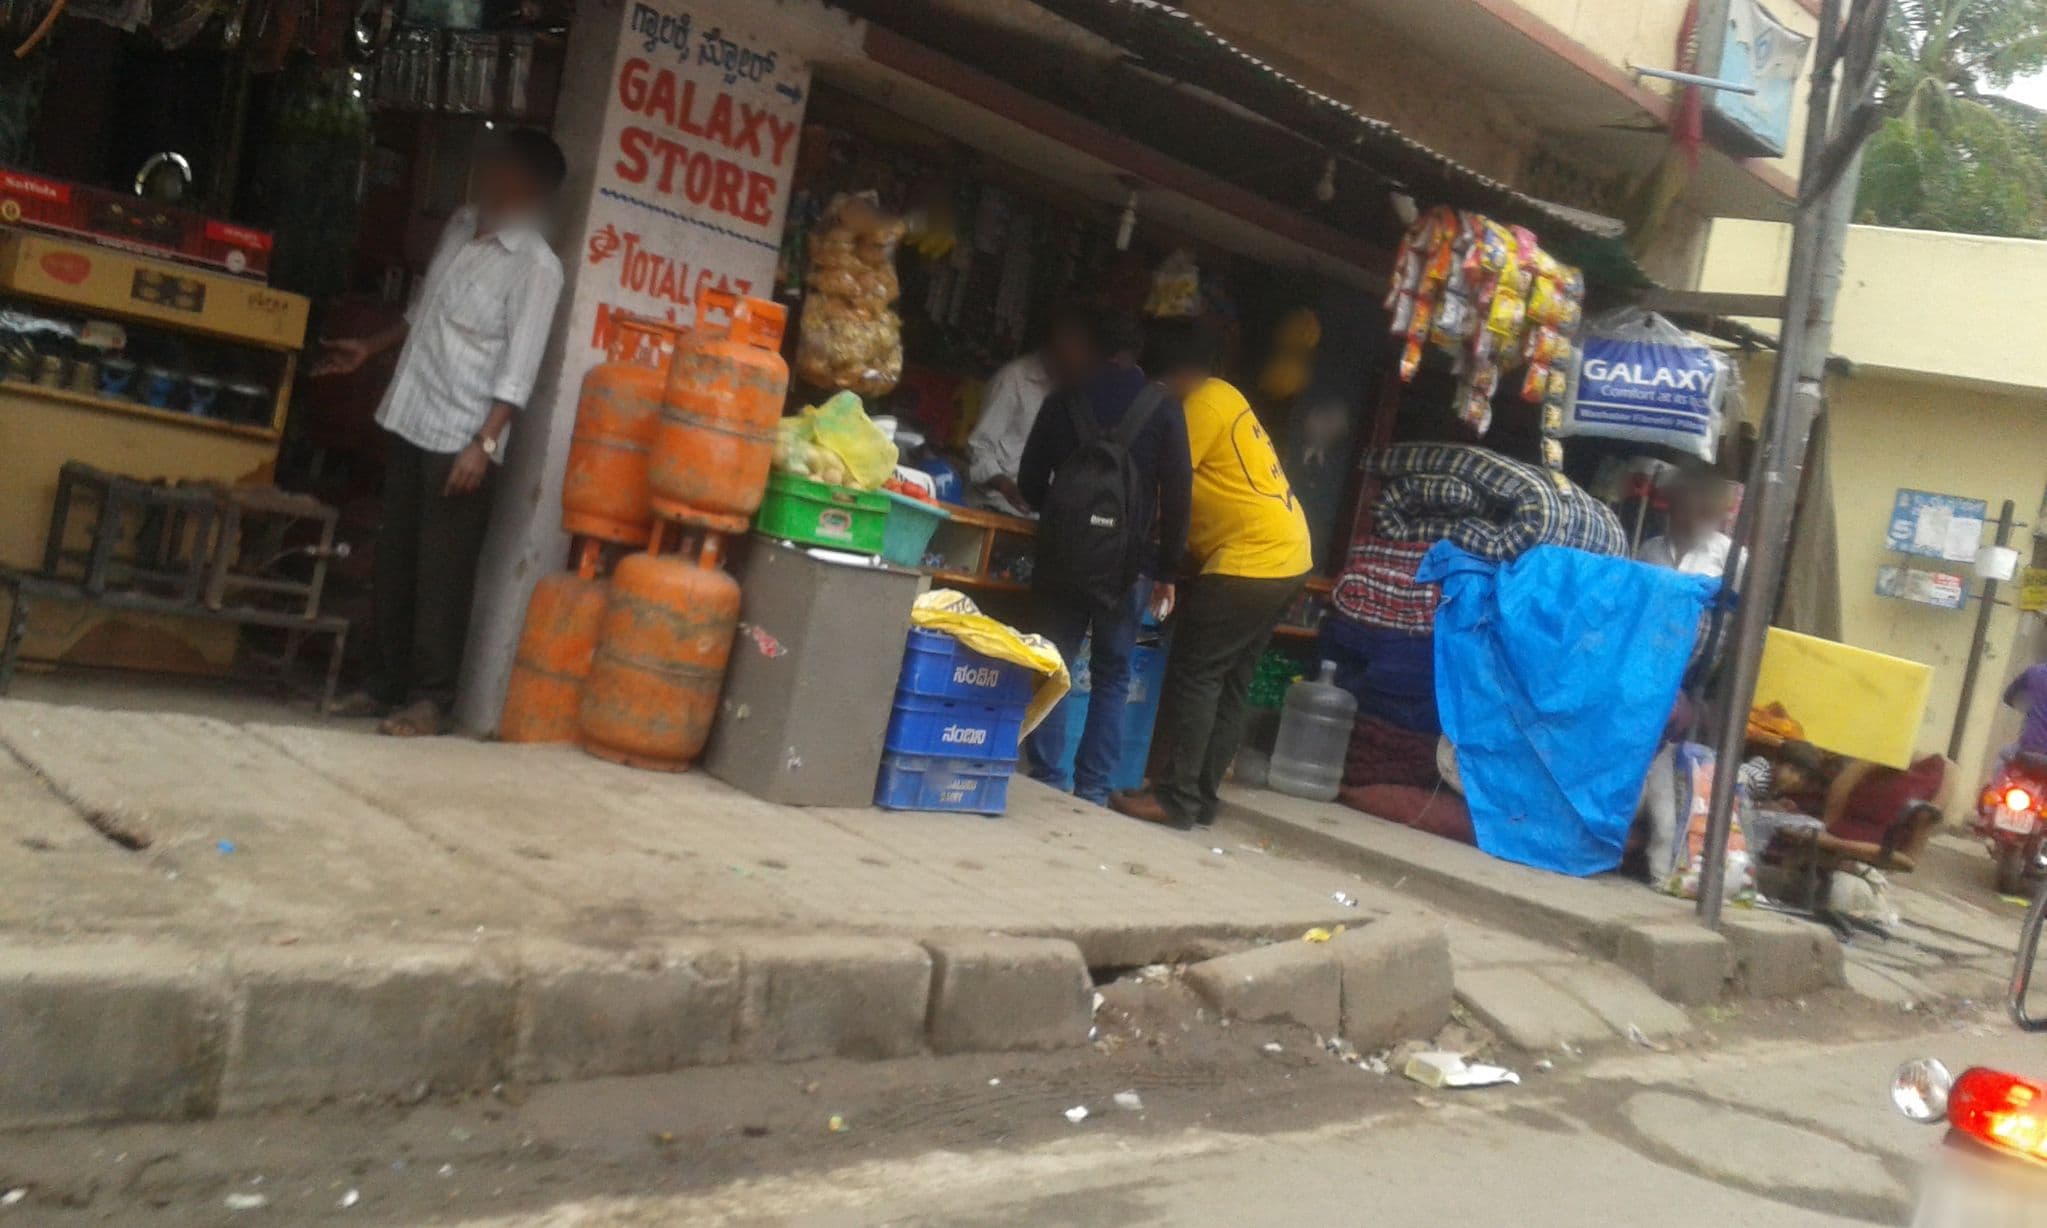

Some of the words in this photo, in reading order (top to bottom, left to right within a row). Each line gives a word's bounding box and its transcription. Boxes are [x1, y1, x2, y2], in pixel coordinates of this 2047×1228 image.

[619, 57, 796, 166] GALAXY
[615, 126, 776, 227] STORE
[1583, 358, 1714, 391] GALAXY
[1601, 384, 1655, 401] Comfort
